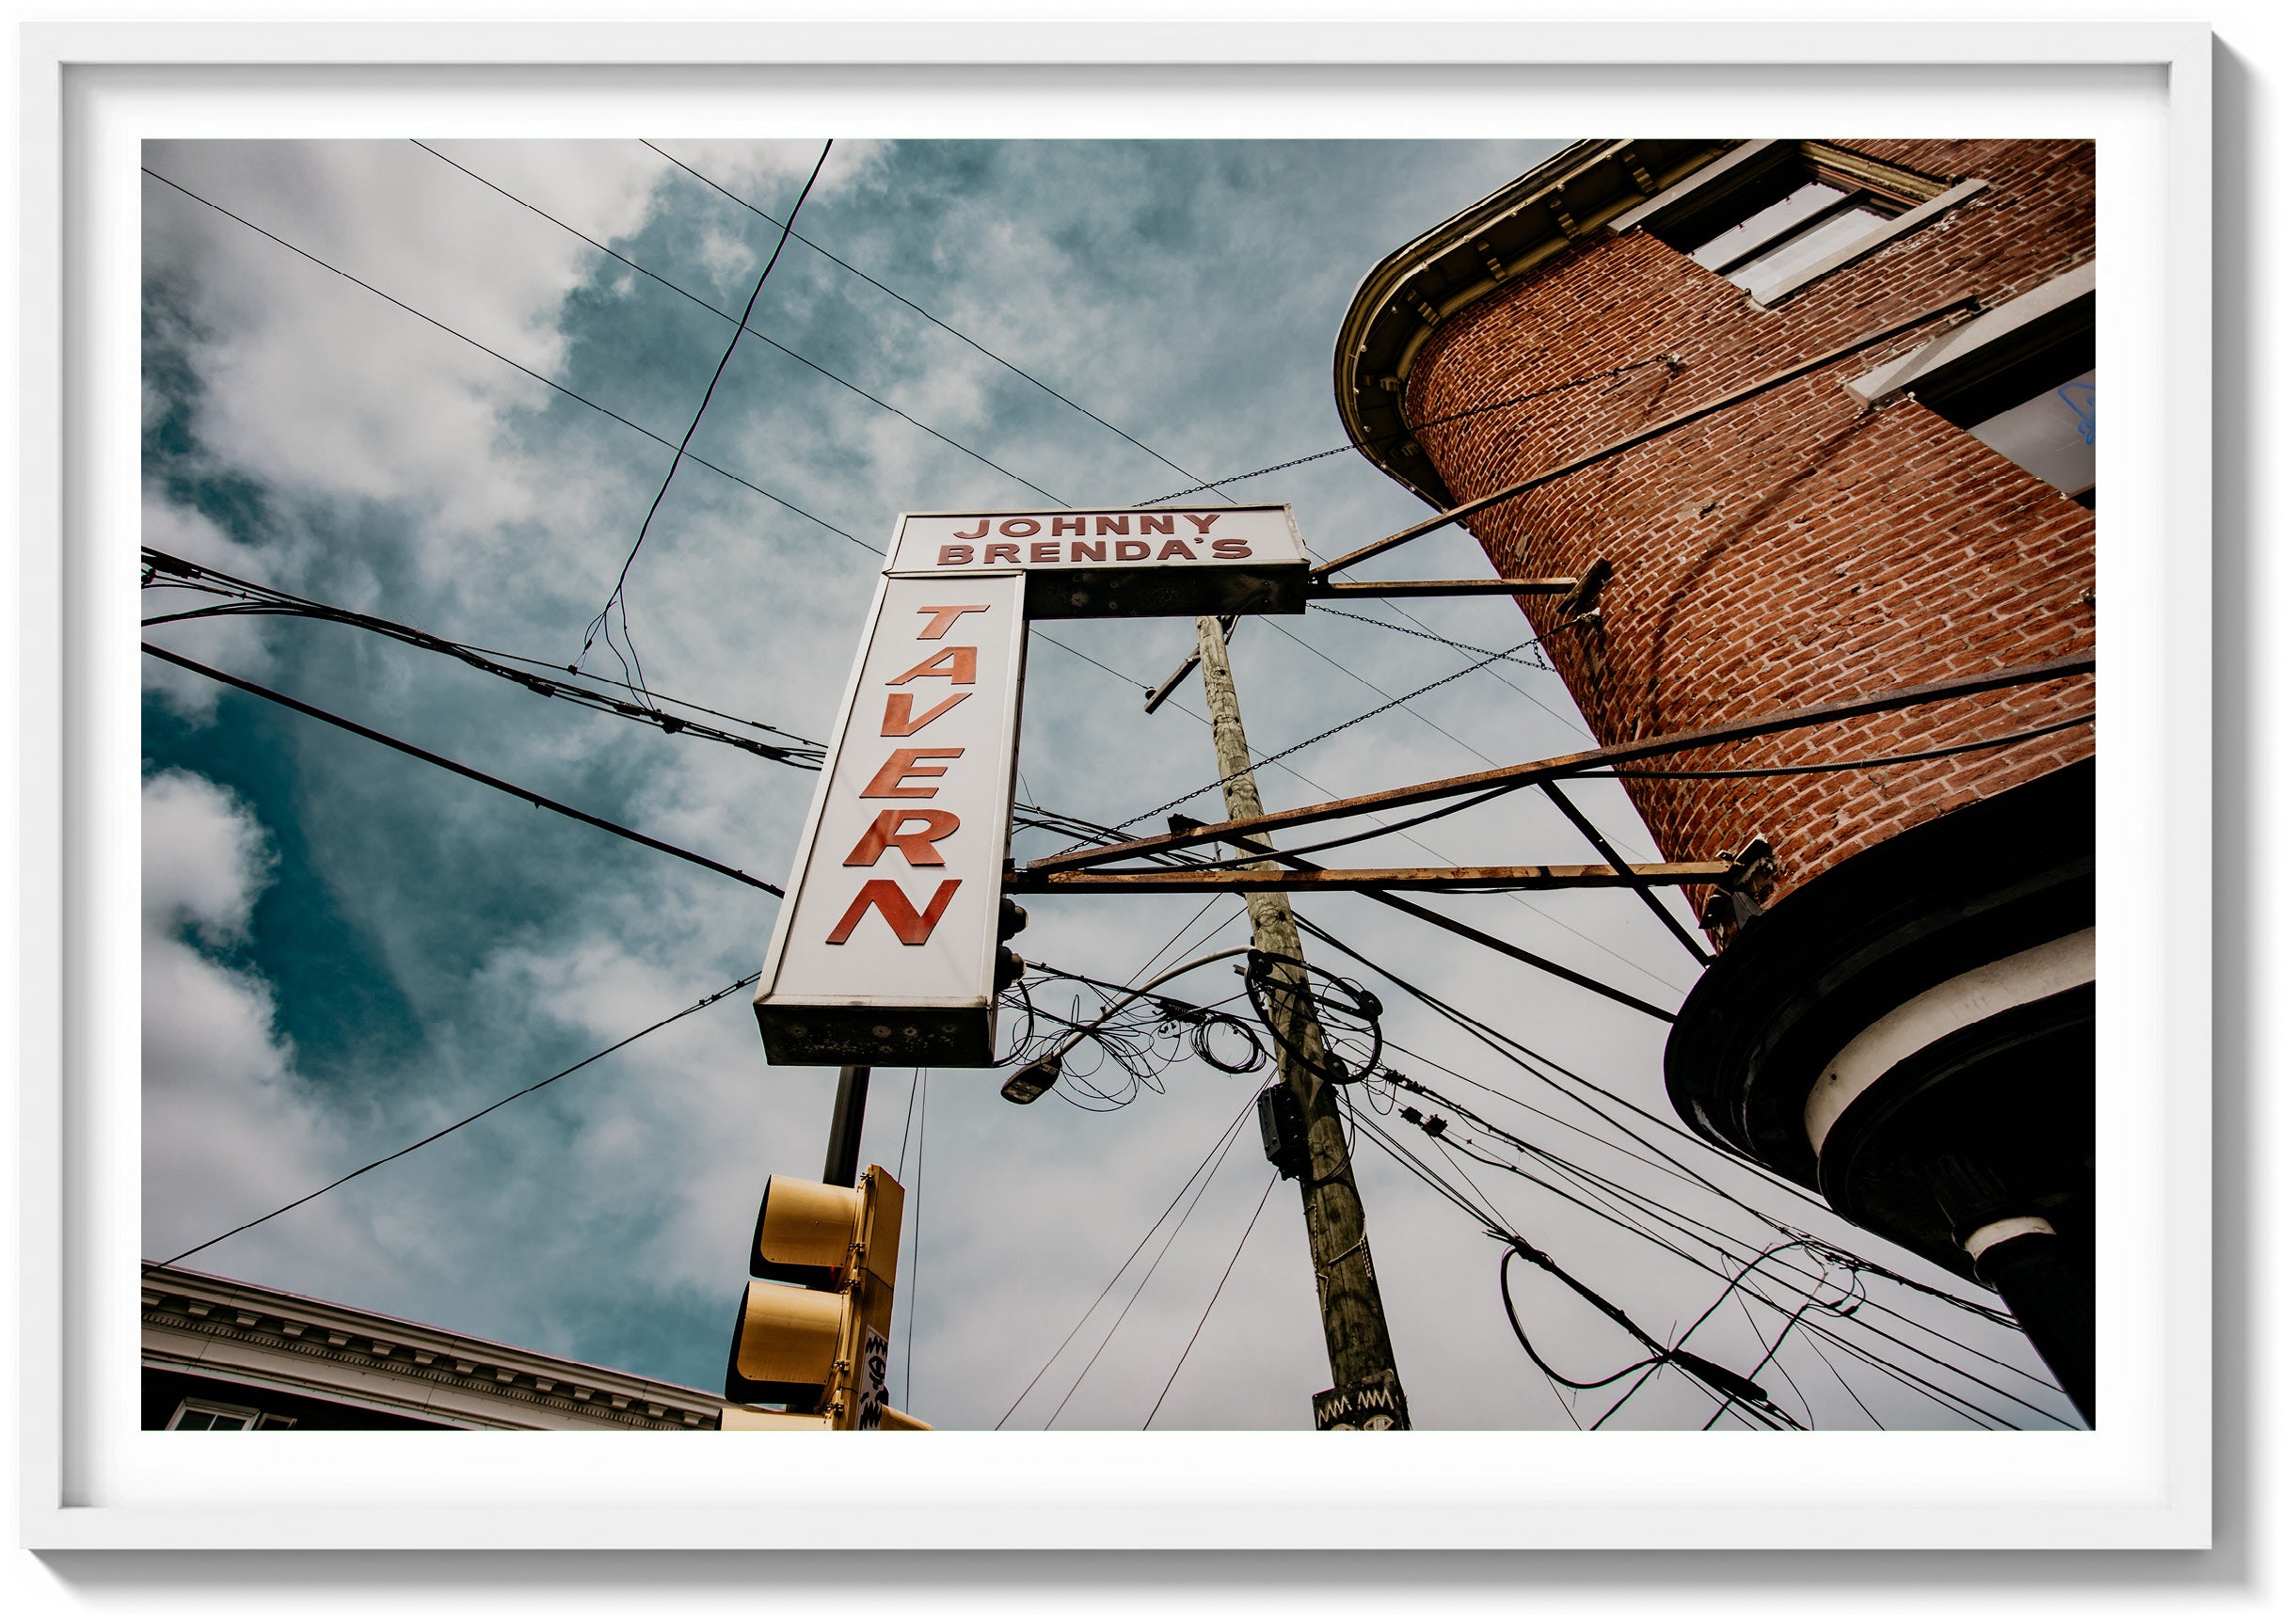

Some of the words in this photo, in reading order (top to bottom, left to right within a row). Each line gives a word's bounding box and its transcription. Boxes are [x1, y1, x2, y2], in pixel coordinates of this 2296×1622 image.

[953, 514, 1220, 539] JOHNNY
[937, 536, 1253, 565] BRENDA'S
[825, 604, 991, 946] TAVERN
